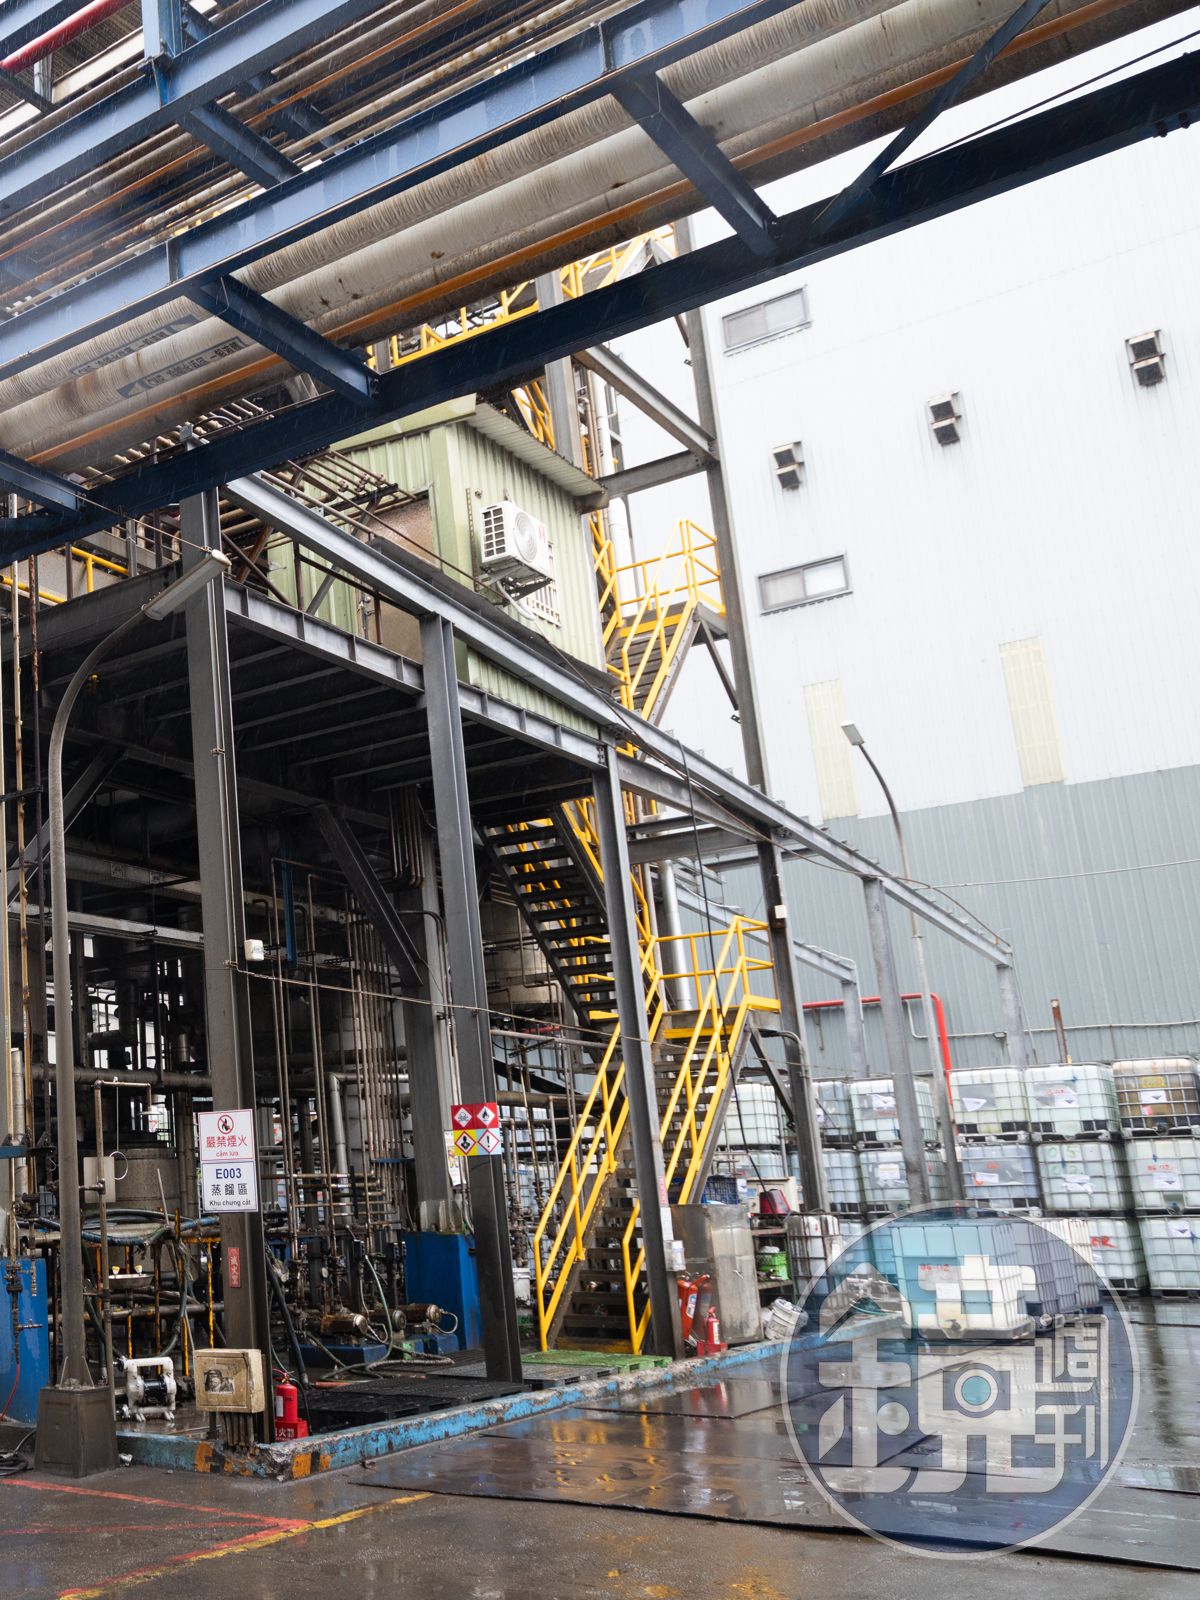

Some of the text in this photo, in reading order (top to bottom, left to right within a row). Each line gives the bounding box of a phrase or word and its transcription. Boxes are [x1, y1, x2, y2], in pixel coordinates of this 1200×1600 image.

[206, 1134, 248, 1148] 嚴禁煙火
[215, 1167, 242, 1179] E003
